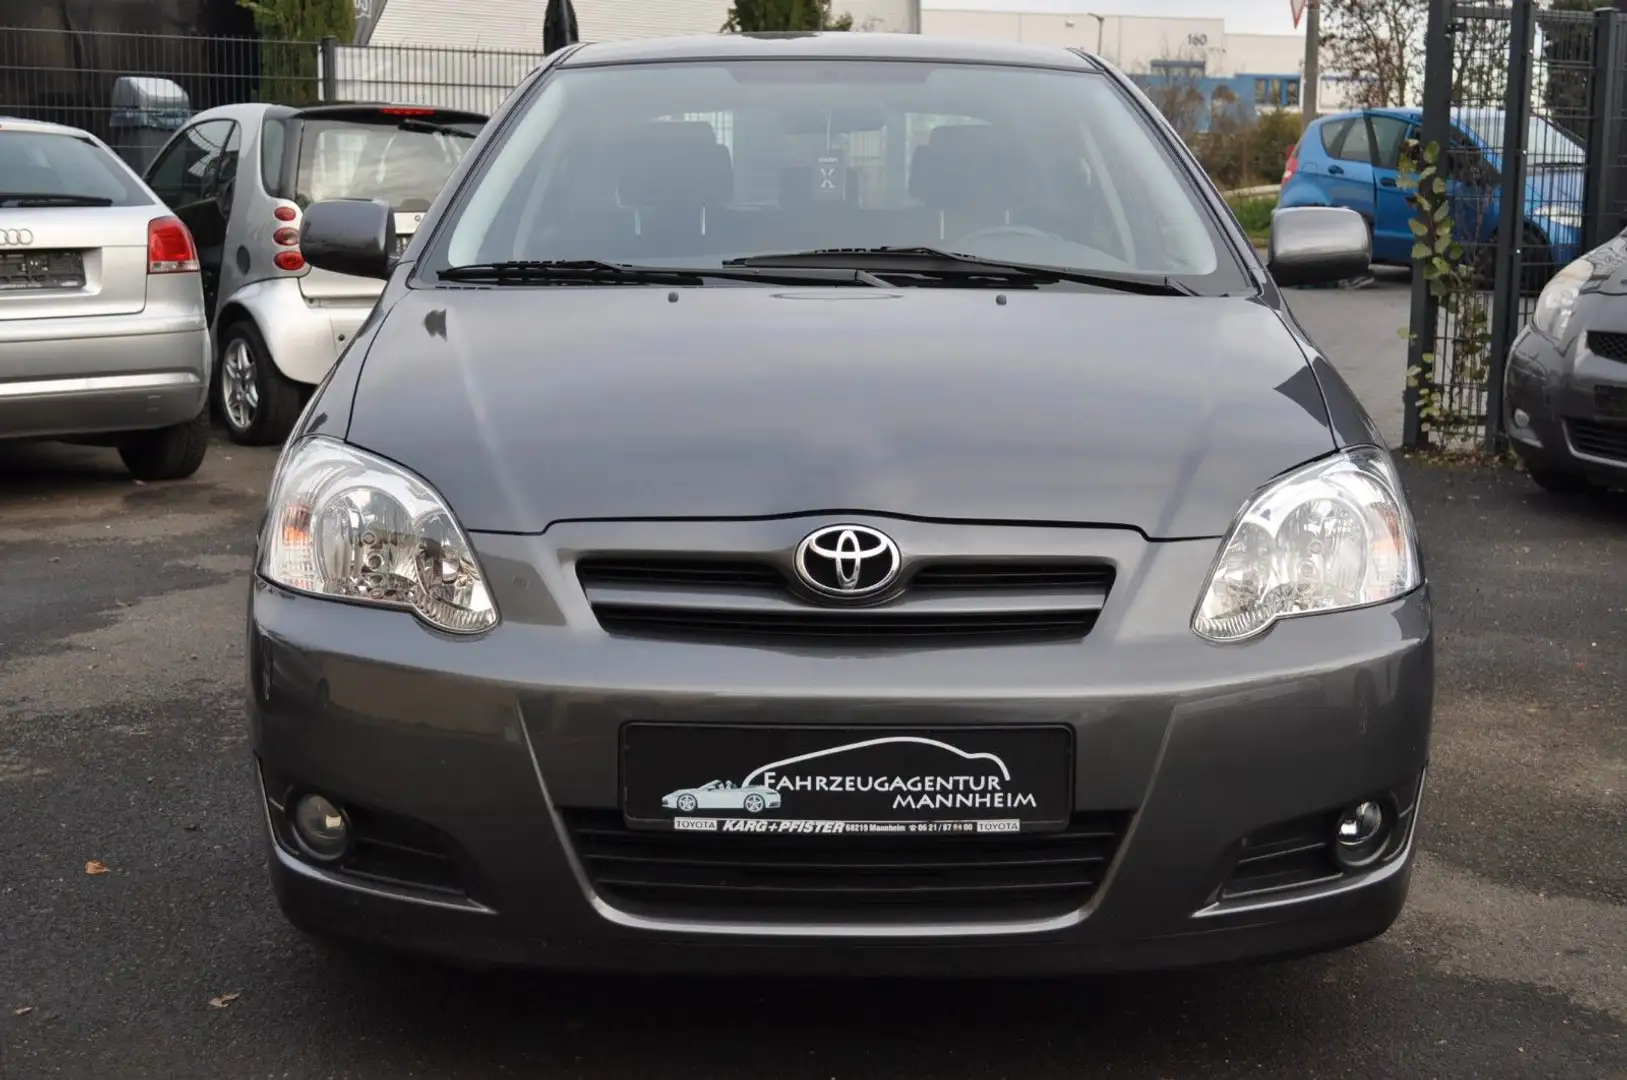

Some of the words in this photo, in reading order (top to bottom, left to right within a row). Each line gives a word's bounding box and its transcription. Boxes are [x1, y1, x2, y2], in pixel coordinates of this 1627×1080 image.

[1188, 33, 1207, 46] 160
[764, 772, 1001, 792] FAHRZEUGAGENTUR
[892, 793, 1037, 808] MANNHEIM
[676, 820, 716, 829] TOYOTA
[869, 823, 906, 832] Mannheim
[979, 822, 1018, 831] TOYOTA
